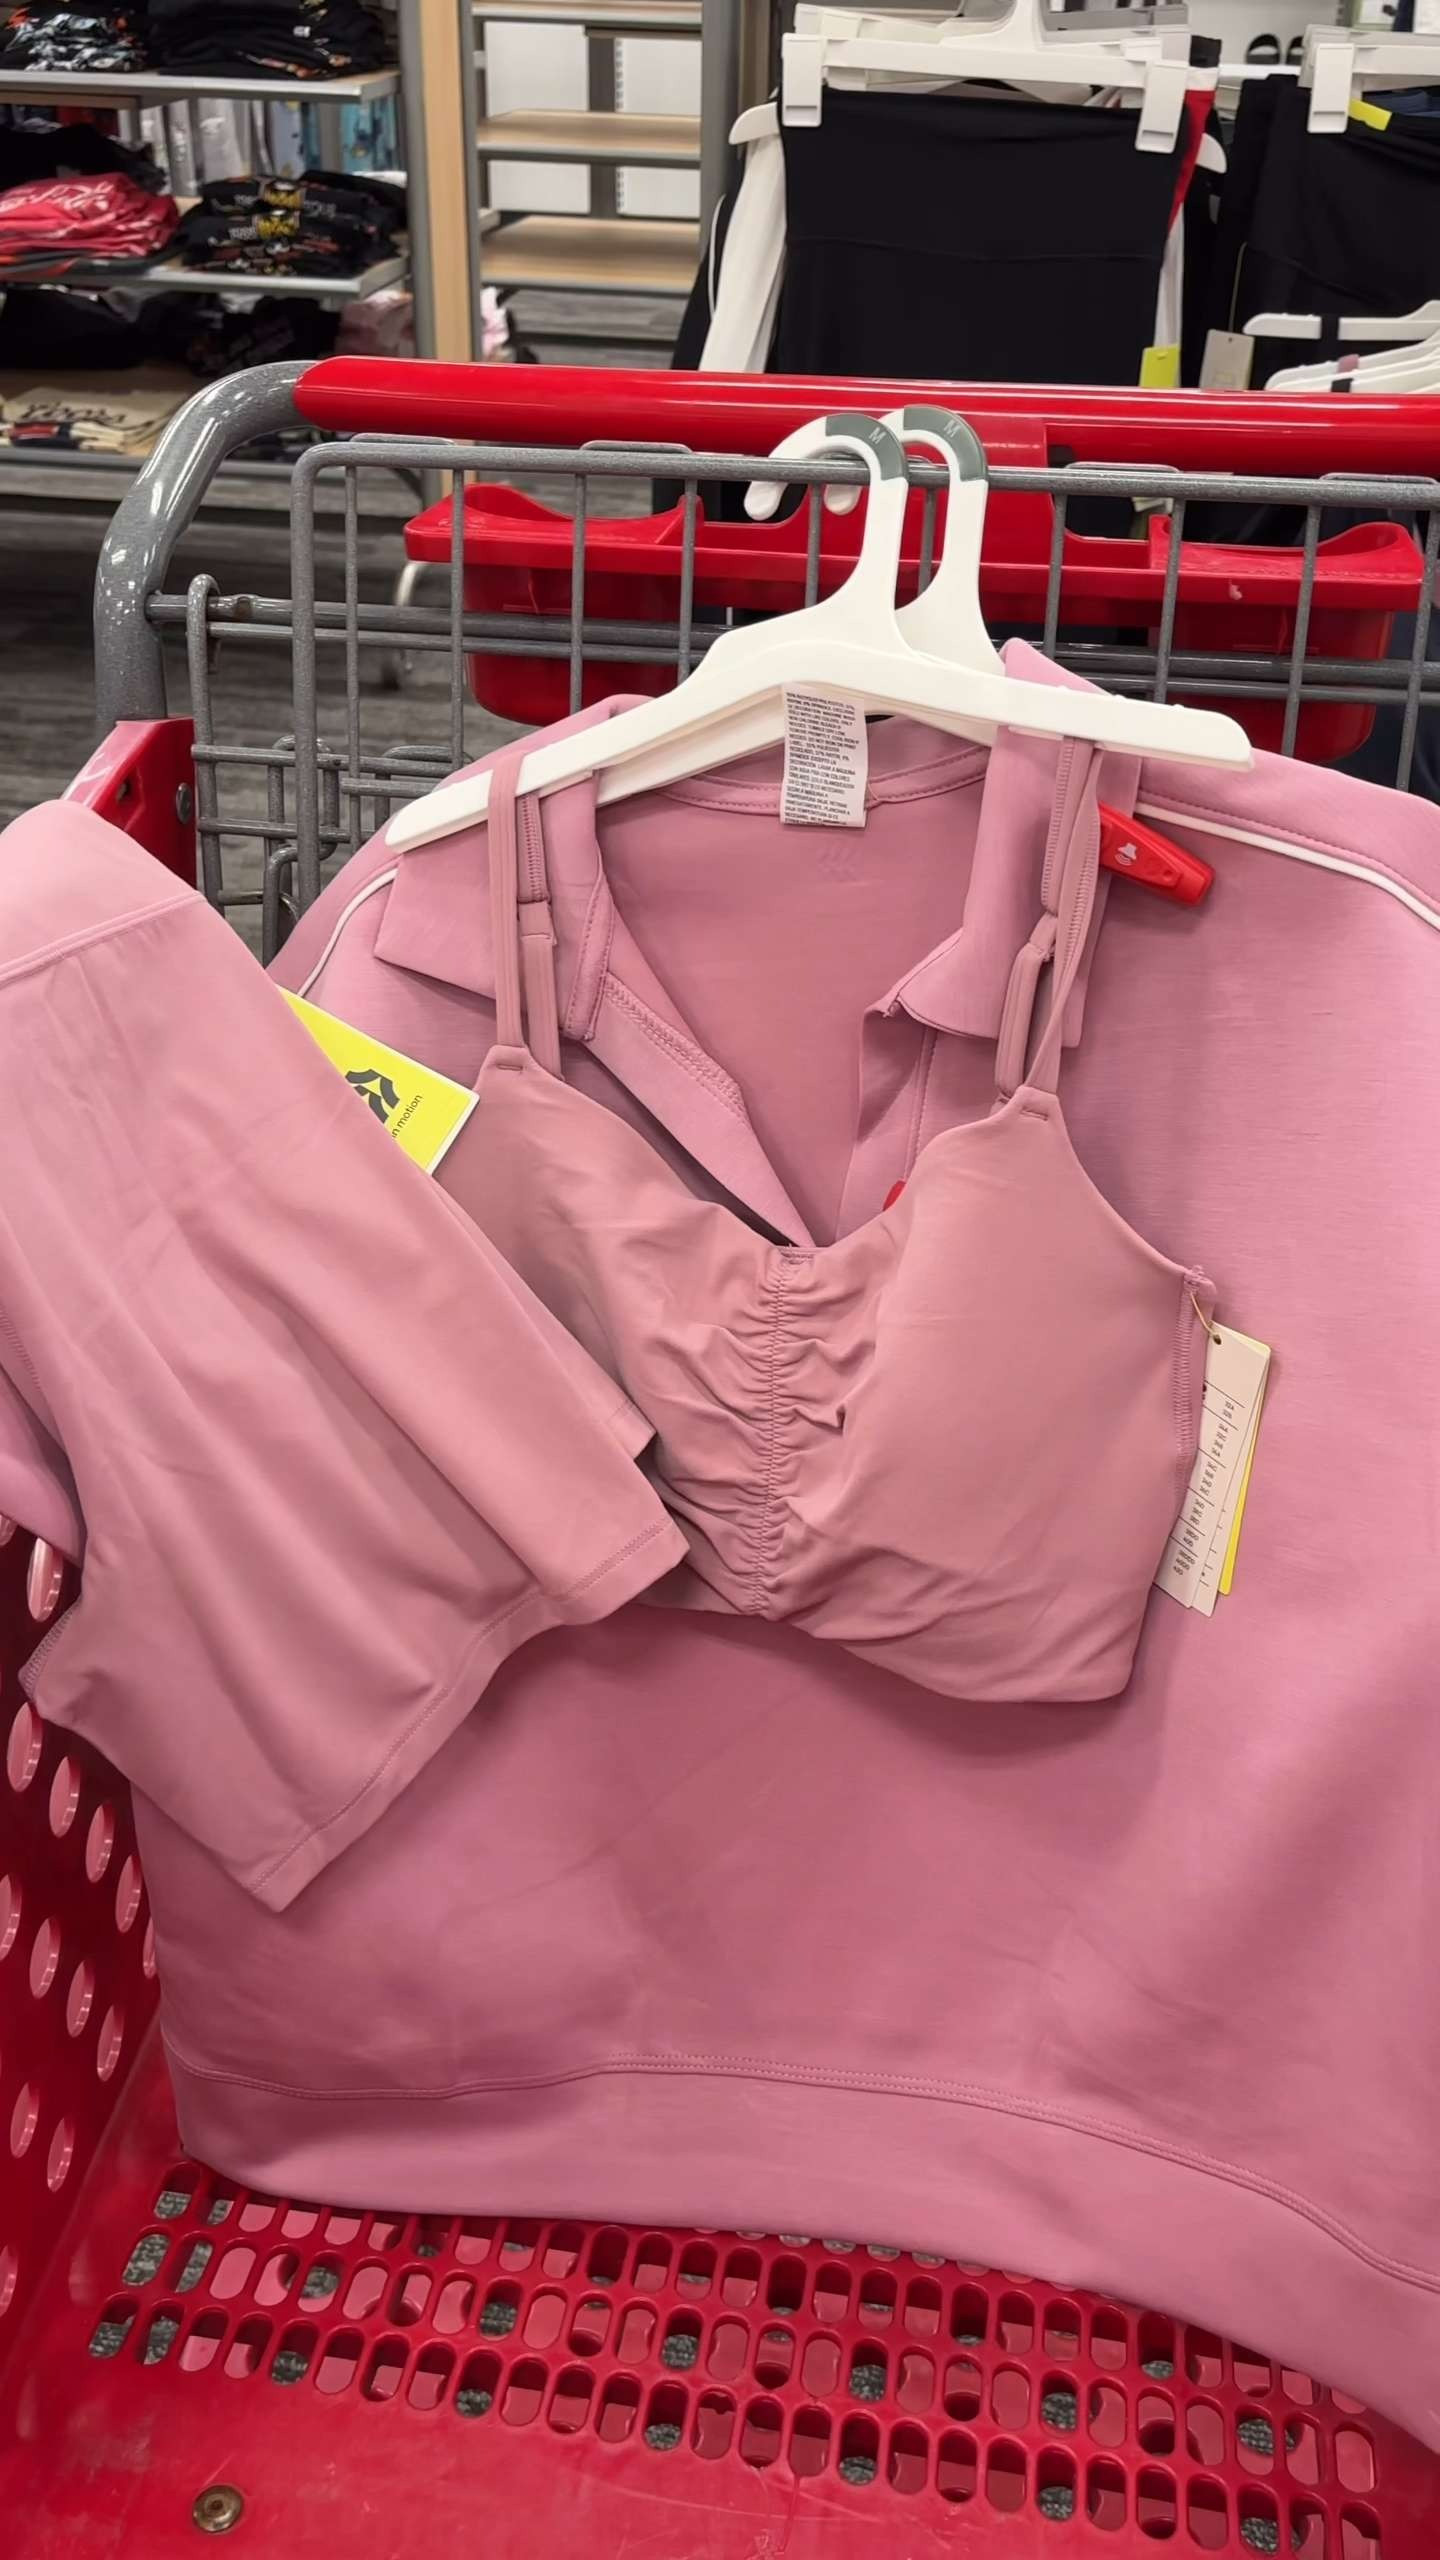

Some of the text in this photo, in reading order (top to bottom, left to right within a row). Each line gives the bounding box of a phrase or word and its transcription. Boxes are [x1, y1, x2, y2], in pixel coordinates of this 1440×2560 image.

[868, 426, 887, 445] M
[943, 419, 961, 438] M
[396, 1095, 423, 1129] motion
